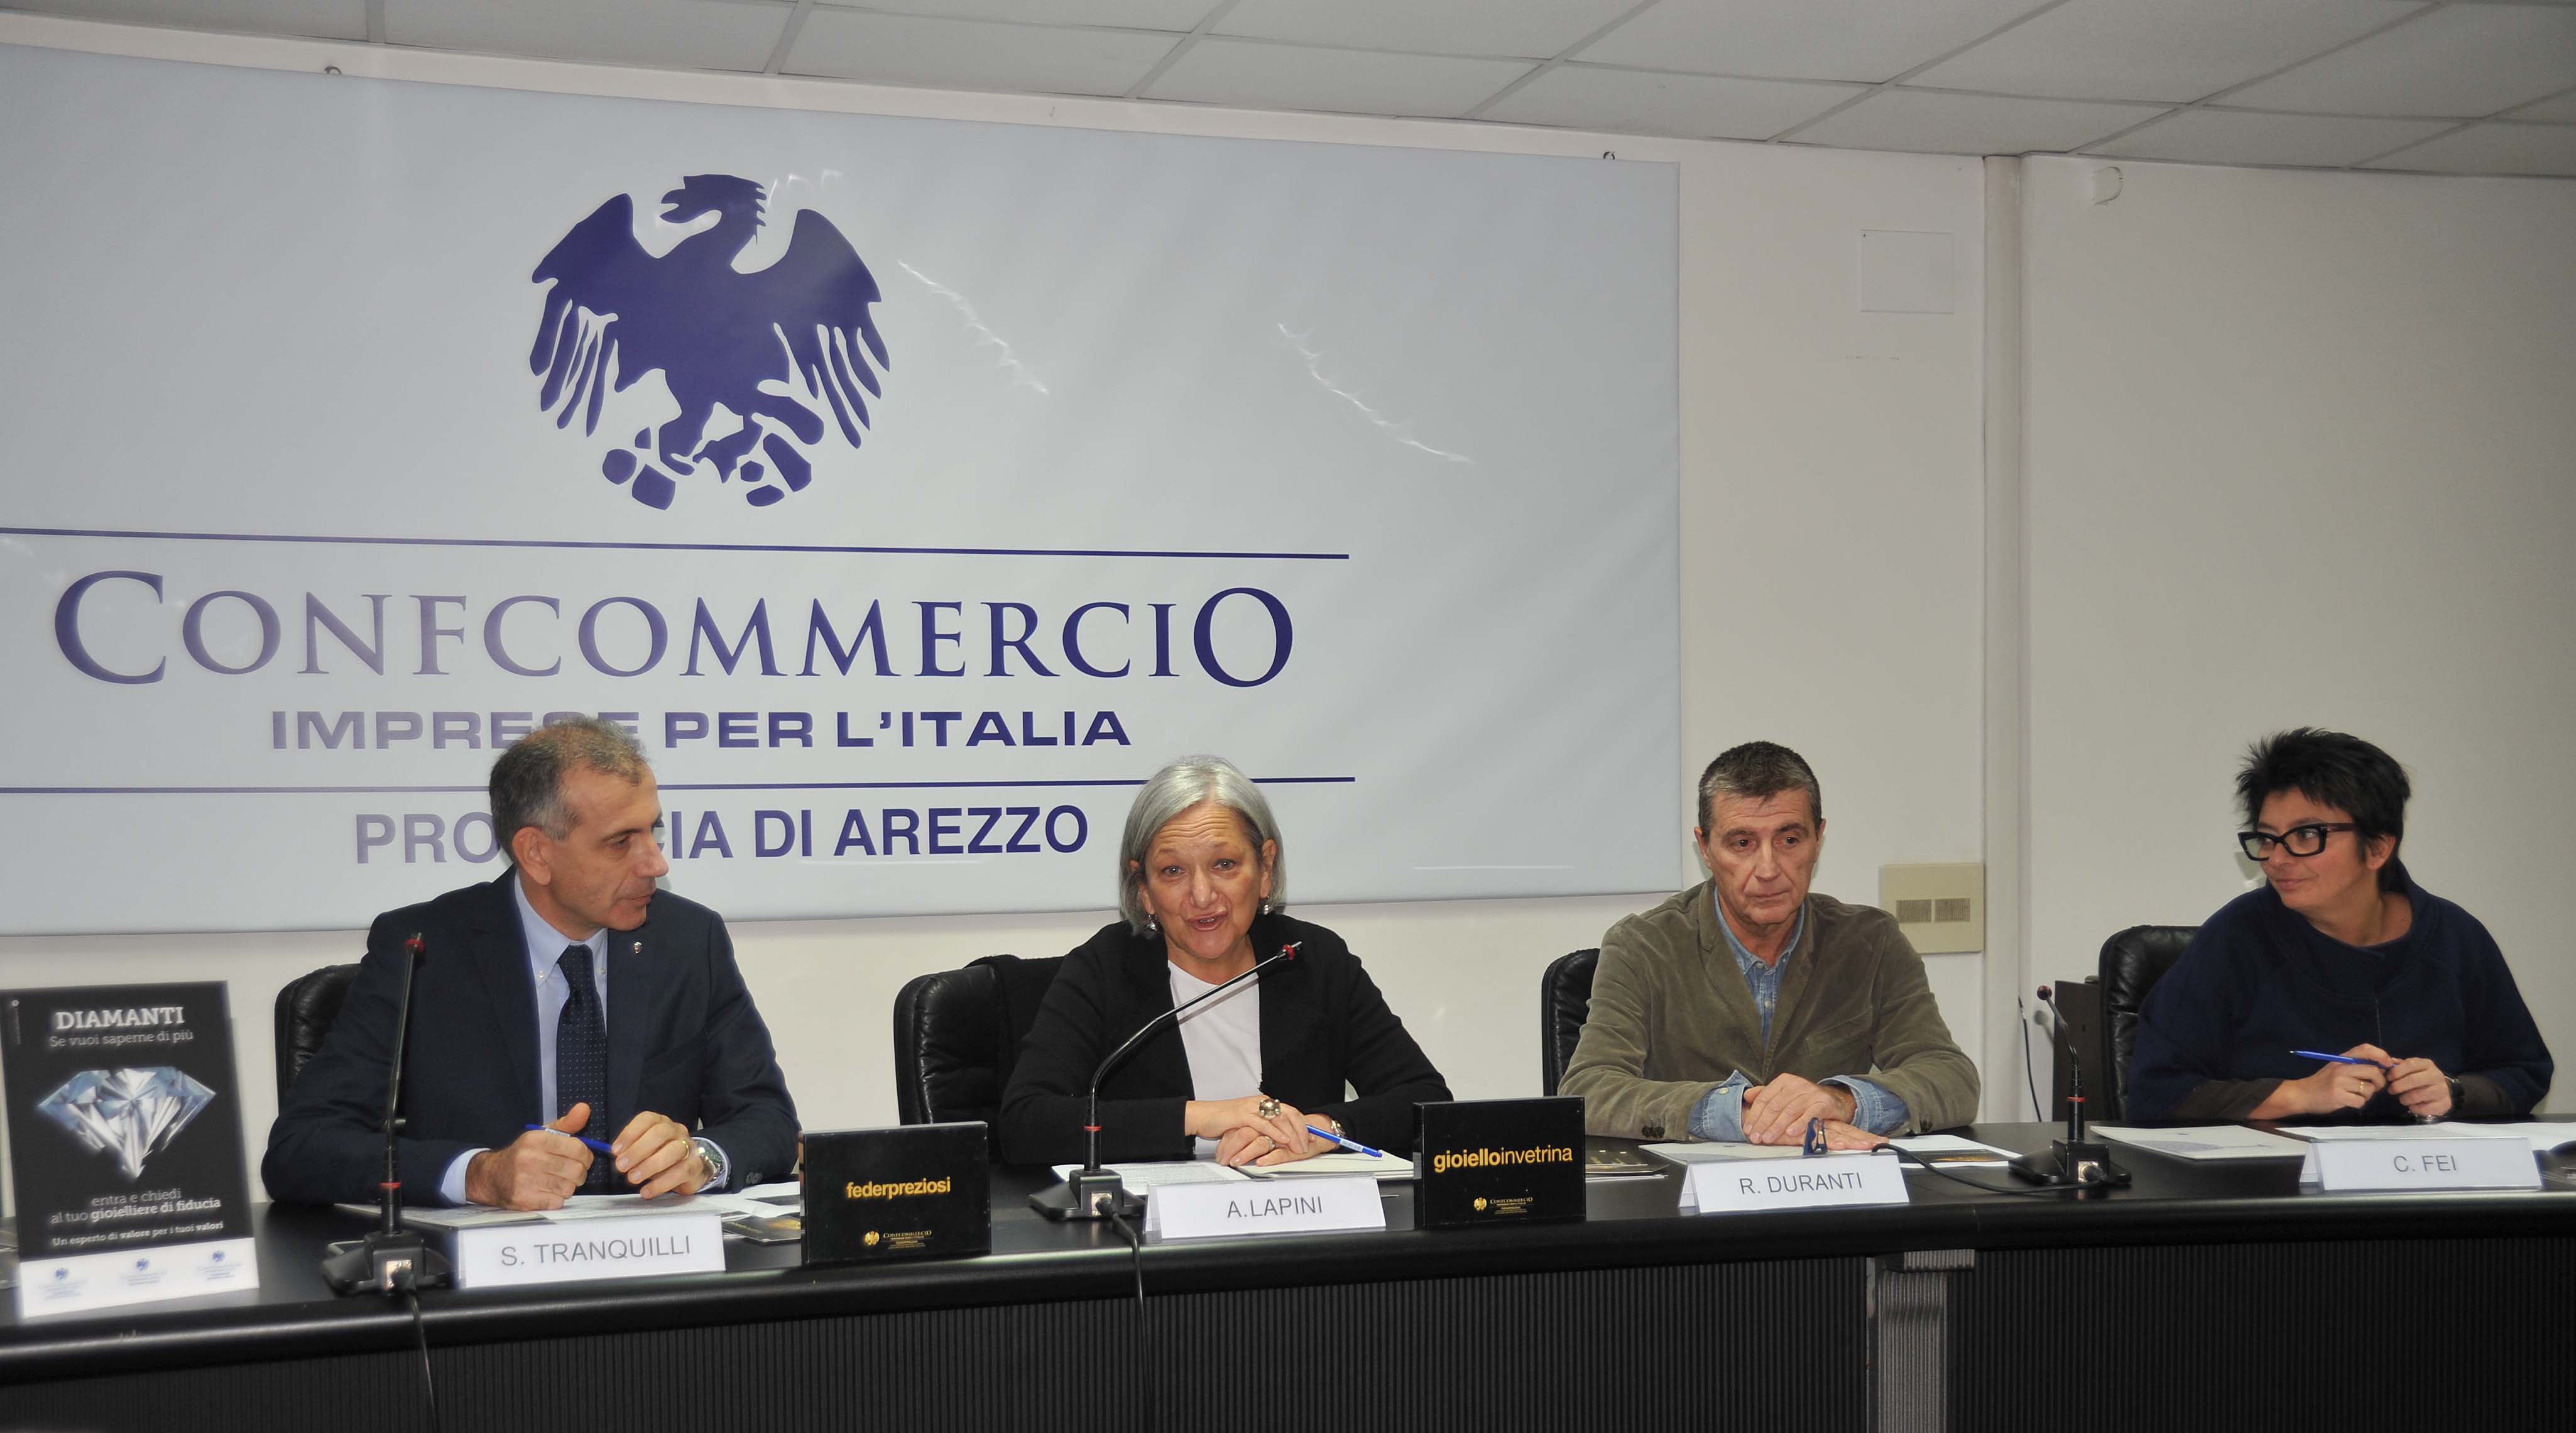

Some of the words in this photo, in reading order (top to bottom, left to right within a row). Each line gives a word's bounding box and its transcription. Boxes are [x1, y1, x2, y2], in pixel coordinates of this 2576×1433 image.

[55, 570, 1293, 688] CONFCOMMERCIO
[665, 711, 813, 749] PER
[836, 711, 1132, 747] L'ITALIA
[356, 810, 734, 864] PROIA
[755, 809, 812, 858] DI
[833, 805, 1088, 857] AREZZO
[55, 1006, 185, 1029] DIAMANTI
[50, 1036, 66, 1047] Se
[70, 1034, 99, 1046] vuoi
[102, 1033, 155, 1047] saperne
[157, 1031, 169, 1041] di
[173, 1029, 194, 1043] più
[1434, 1145, 1573, 1173] gioielloinvetrina
[2393, 1155, 2416, 1172] C.
[2421, 1155, 2457, 1172] FEI
[846, 1176, 951, 1200] federpreziosi
[1739, 1178, 1761, 1195] R.
[1767, 1172, 1862, 1193] DURANTI
[92, 1195, 126, 1207] entra
[129, 1194, 138, 1202] e
[141, 1188, 182, 1202] chiedi
[51, 1212, 63, 1224] al
[65, 1212, 89, 1222] tuo
[90, 1205, 158, 1222] gioielliere
[160, 1202, 174, 1213] di
[175, 1198, 221, 1212] fiducia
[52, 1238, 68, 1246] Un
[70, 1233, 106, 1245] esperto
[107, 1231, 118, 1240] di
[120, 1229, 151, 1239] valore
[152, 1228, 168, 1238] per
[175, 1224, 194, 1233] tuoi
[195, 1221, 224, 1231] valori
[501, 1246, 525, 1266] S.
[533, 1235, 690, 1264] TRANQUILLI
